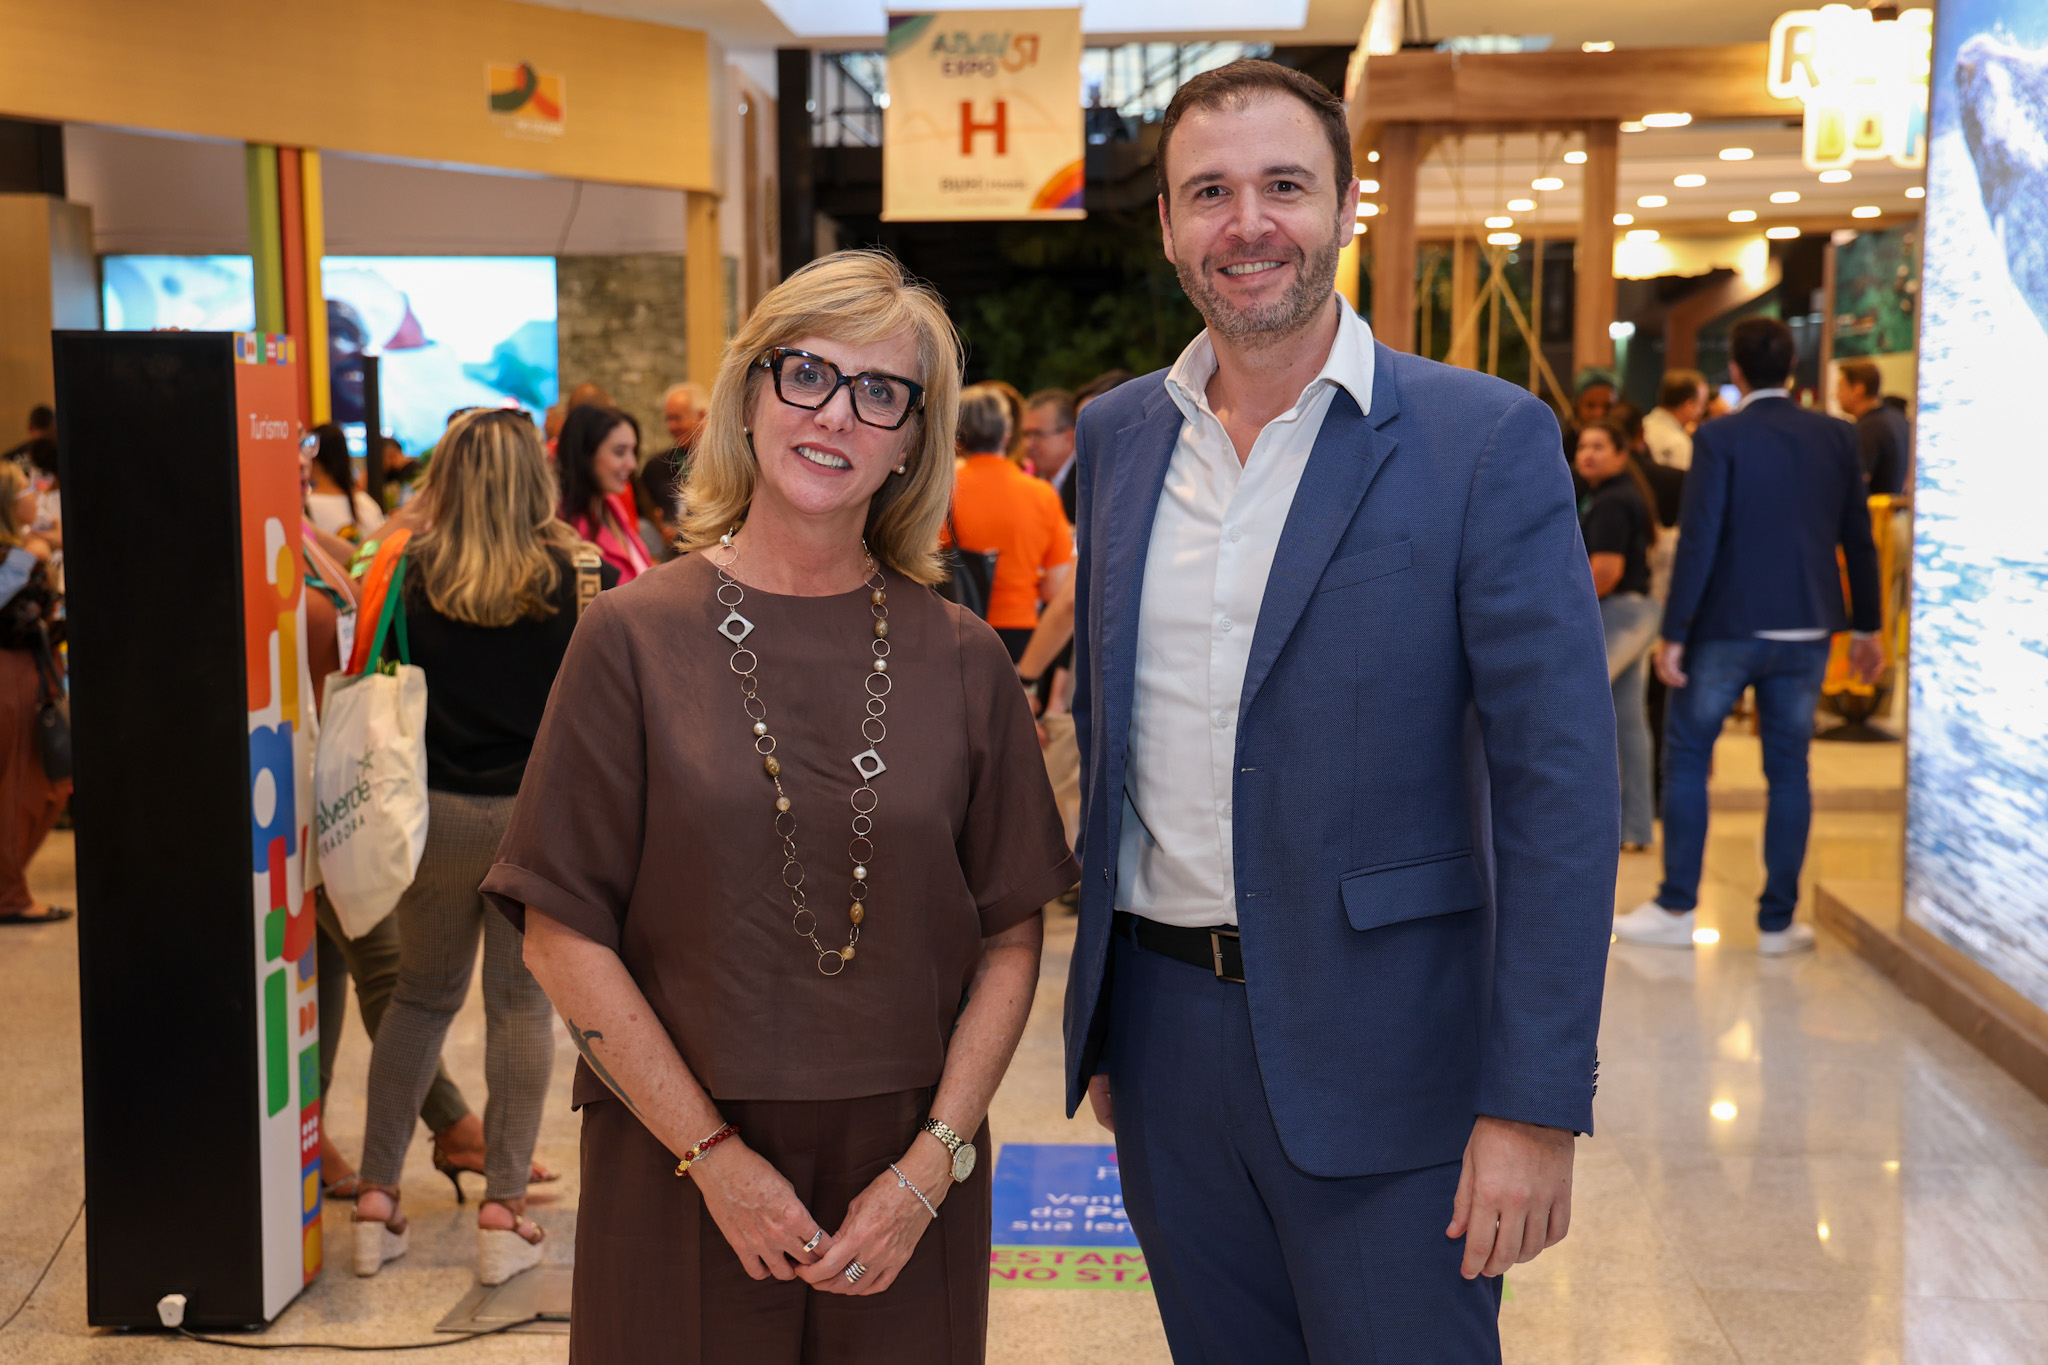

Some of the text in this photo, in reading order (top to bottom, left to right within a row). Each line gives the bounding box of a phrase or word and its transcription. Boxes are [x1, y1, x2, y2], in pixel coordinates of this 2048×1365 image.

[960, 100, 1006, 156] H
[249, 412, 289, 440] Turismo
[1030, 1206, 1075, 1219] do
[1011, 1220, 1073, 1232] sua
